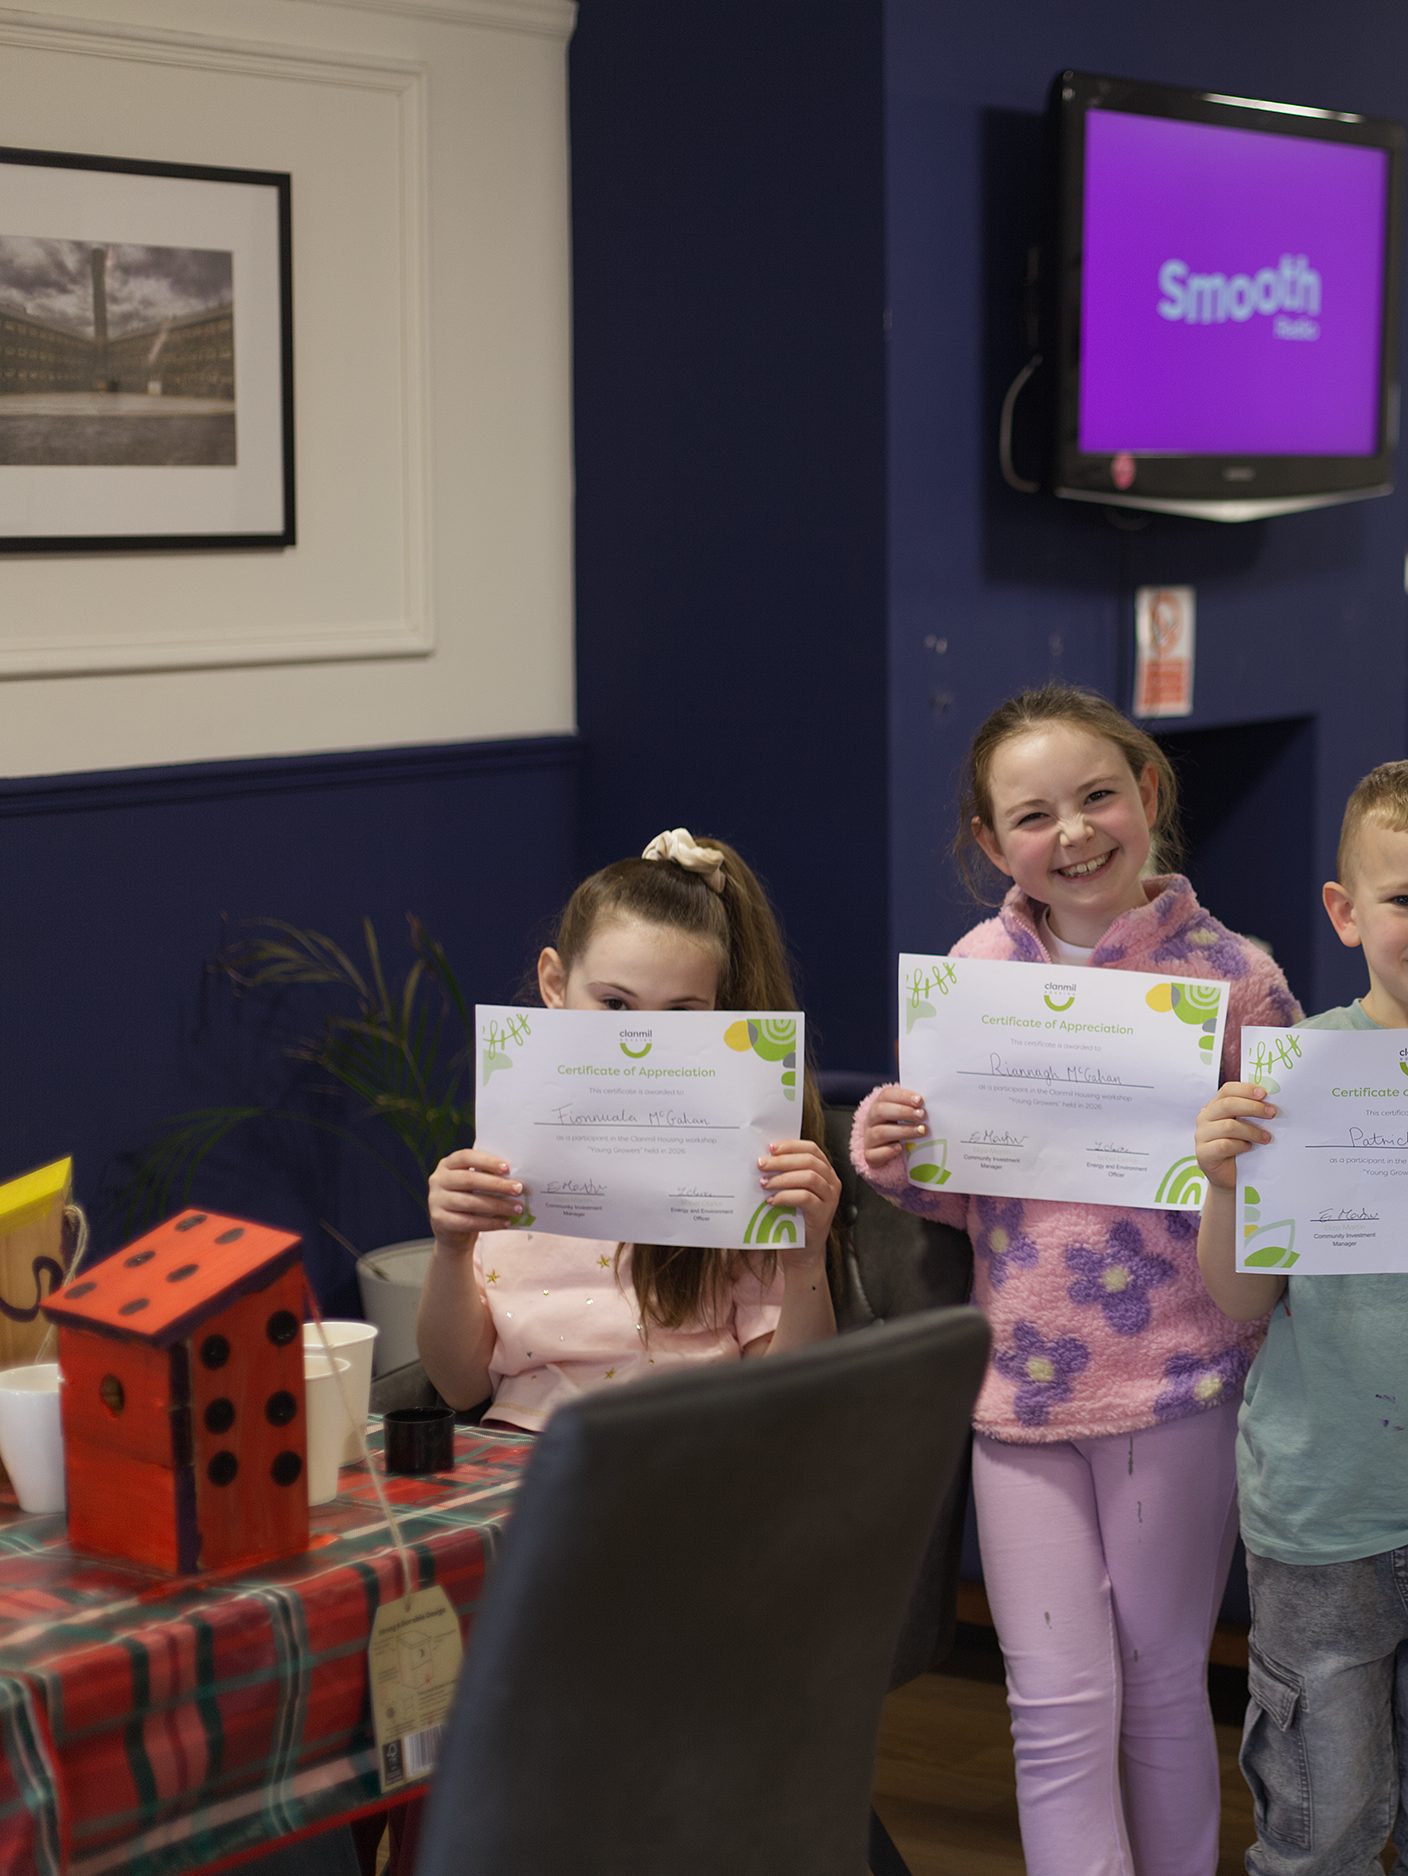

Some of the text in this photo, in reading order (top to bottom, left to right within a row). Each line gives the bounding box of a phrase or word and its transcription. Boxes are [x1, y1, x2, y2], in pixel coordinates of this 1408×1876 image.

[1157, 253, 1322, 325] Smooth
[1044, 982, 1077, 991] clanmil
[981, 1015, 1134, 1035] Certificate of Appreciation
[619, 1030, 652, 1038] clanmil
[1010, 1038, 1022, 1046] This
[1024, 1039, 1056, 1048] certificate
[1064, 1042, 1093, 1051] awarded
[557, 1065, 716, 1079] Certificate of Appreciation
[990, 1052, 1059, 1086] Riannagh
[1332, 1087, 1399, 1097] Certificate
[551, 1103, 638, 1125] Fionnuala
[1346, 1156, 1385, 1166] participant
[425, 1608, 446, 1618] Design
